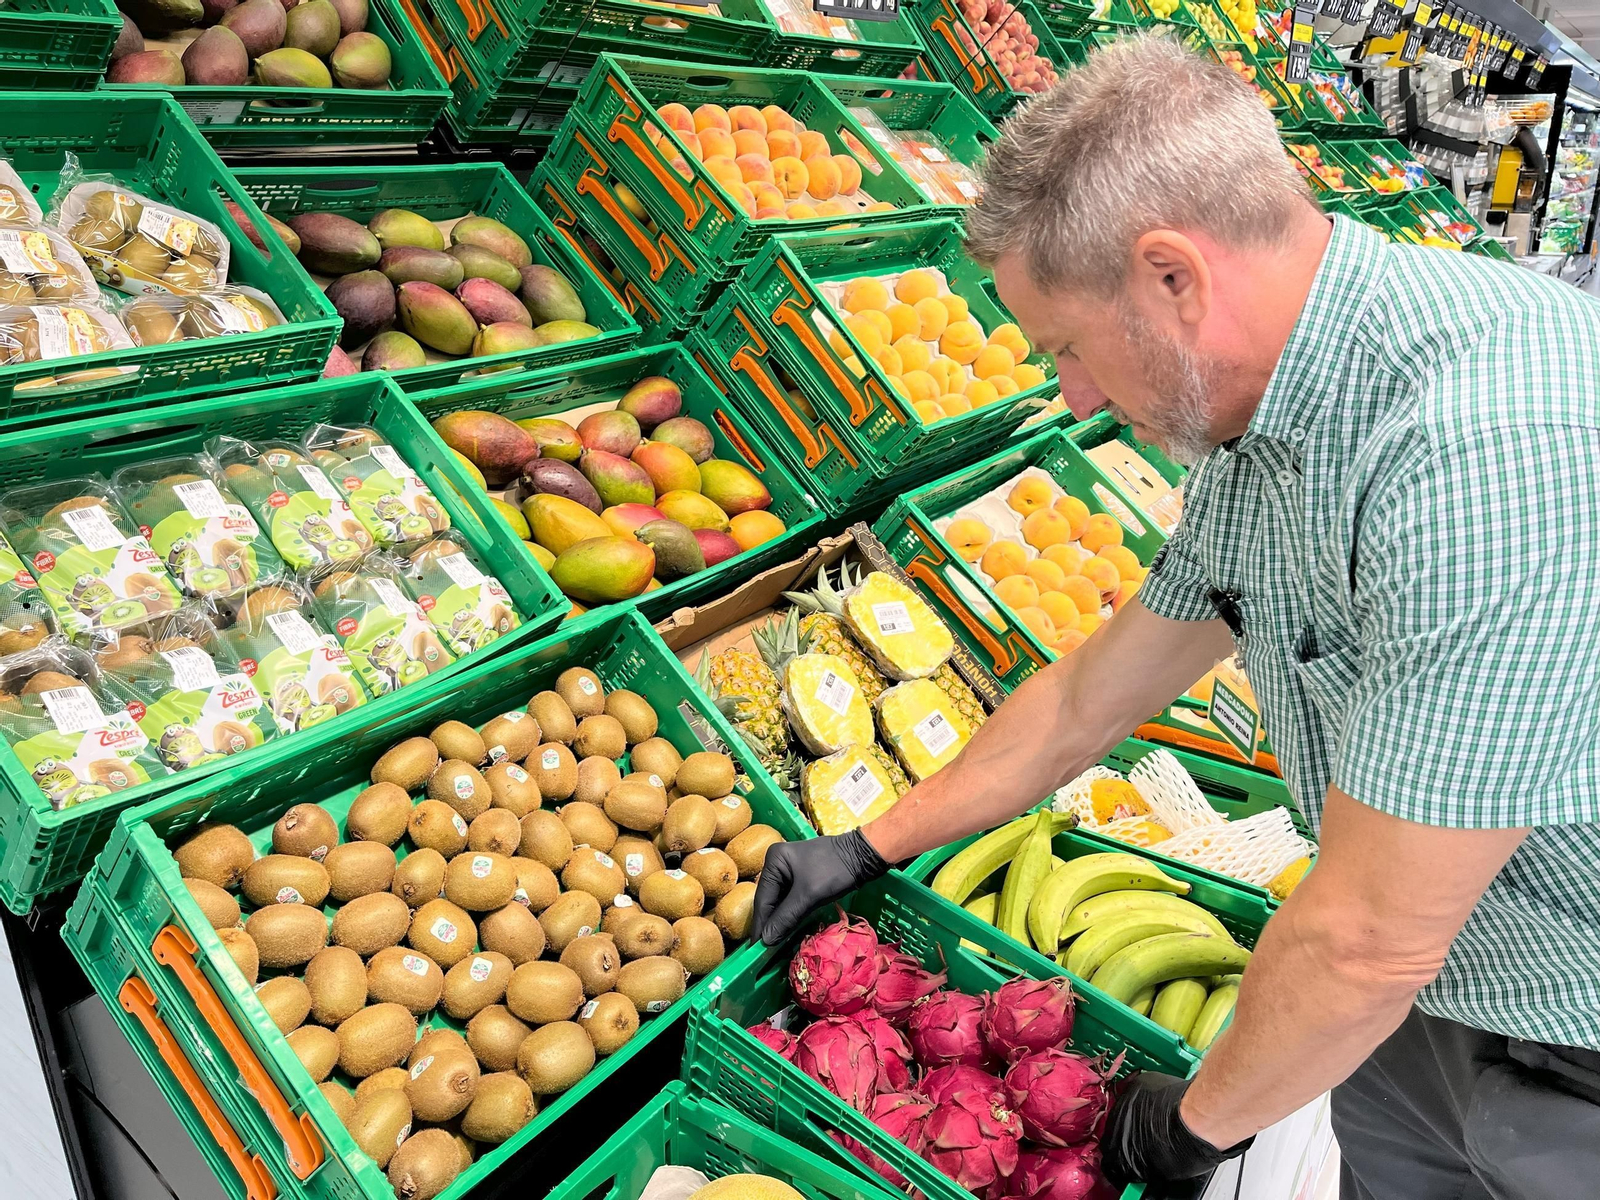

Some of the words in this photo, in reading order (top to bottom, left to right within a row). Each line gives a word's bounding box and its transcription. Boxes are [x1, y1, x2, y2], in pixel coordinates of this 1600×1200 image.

[35, 556, 53, 568] FIBRE
[952, 644, 999, 698] HONEYG
[216, 687, 257, 709] Zespri
[1215, 683, 1254, 725] MERCADONA
[129, 707, 144, 716] BRE
[237, 708, 258, 720] GREEN
[1214, 703, 1235, 726] ANTONIO
[94, 730, 142, 747] Zespri
